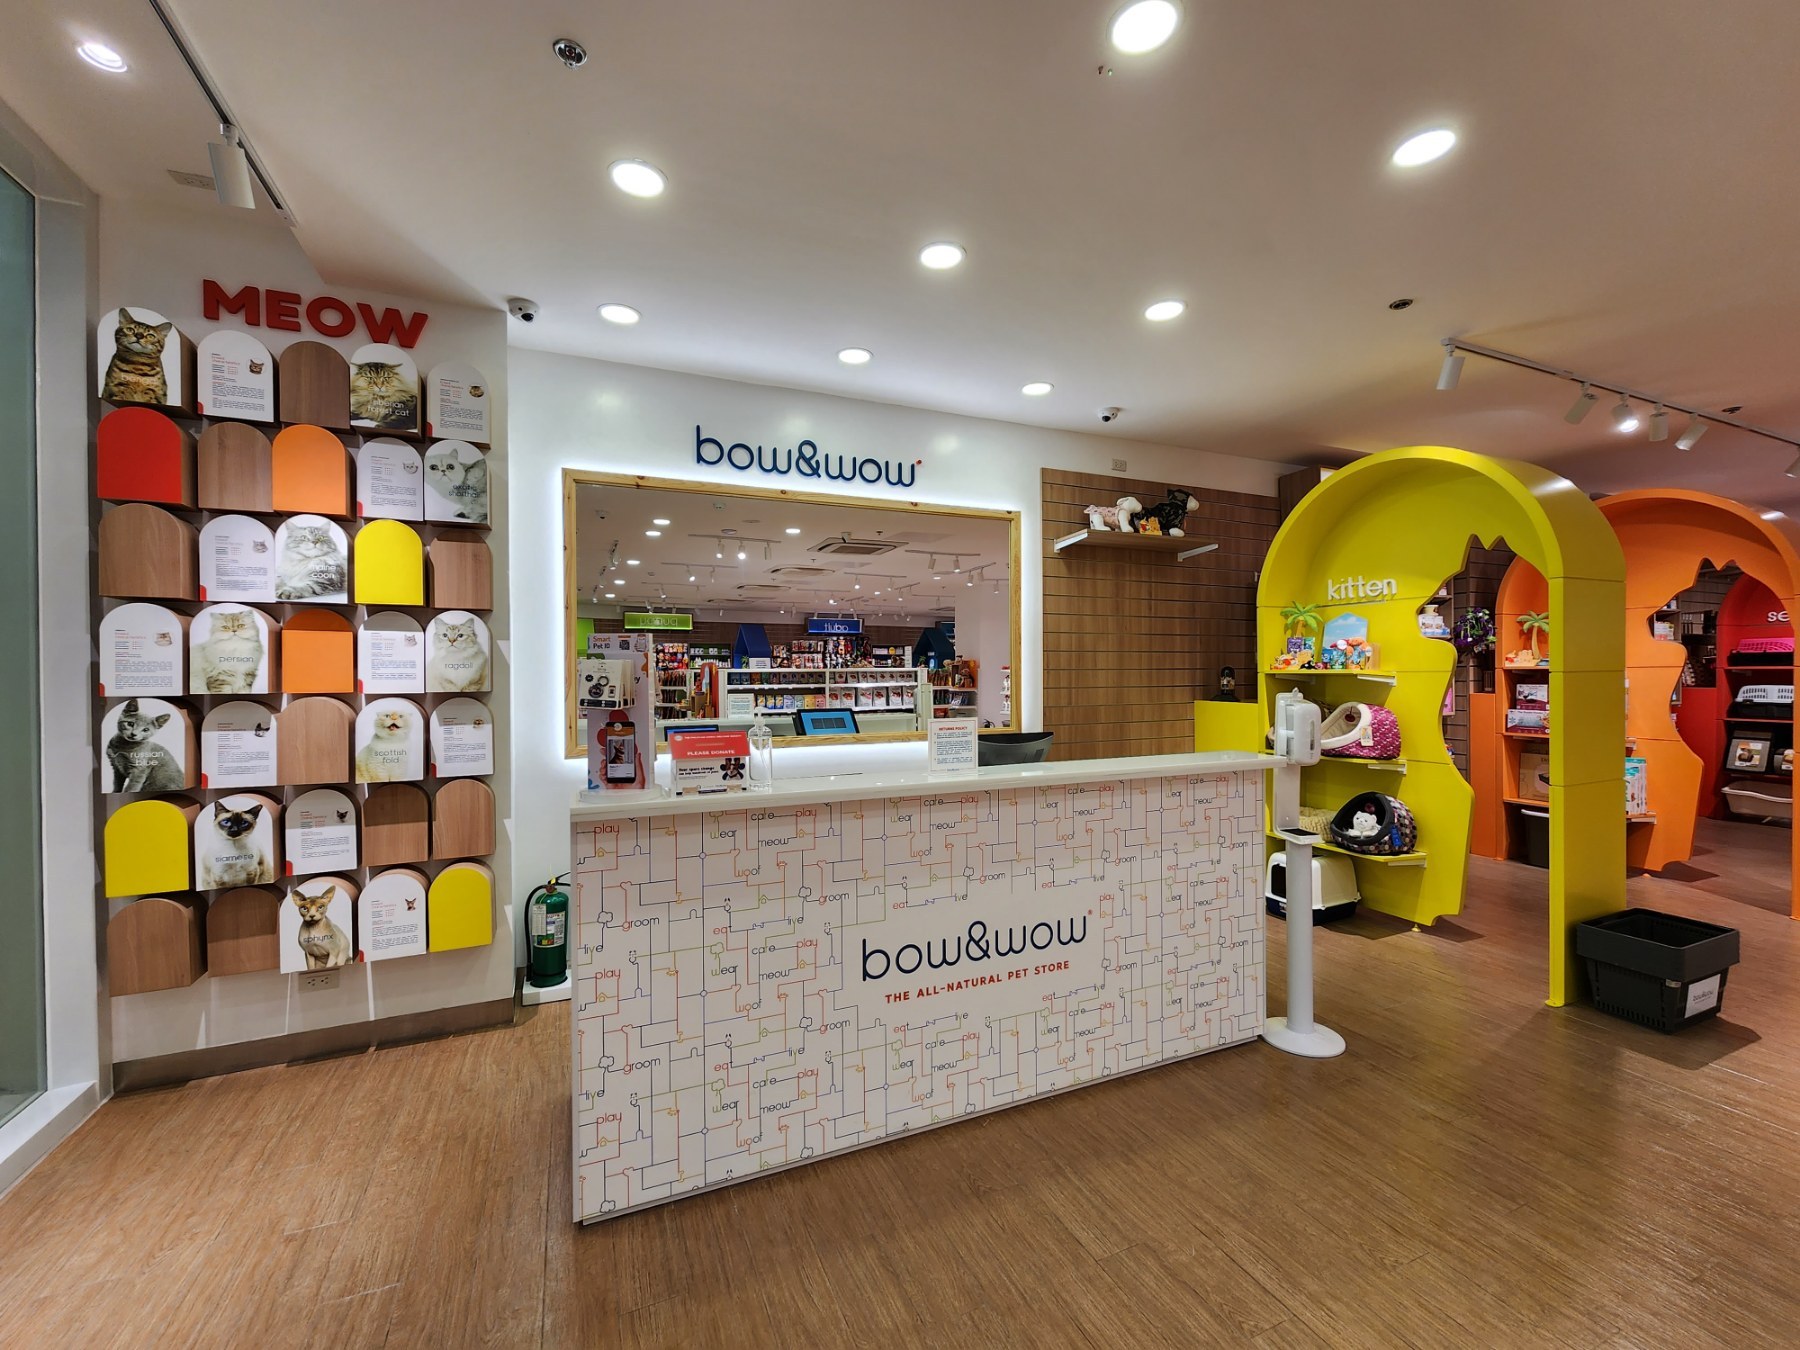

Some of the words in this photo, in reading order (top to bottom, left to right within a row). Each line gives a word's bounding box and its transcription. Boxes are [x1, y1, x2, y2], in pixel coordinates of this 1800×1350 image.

[203, 279, 428, 348] MEOW
[395, 409, 410, 417] cat
[696, 424, 915, 487] bow&wow
[1328, 576, 1398, 600] kitten
[374, 749, 407, 757] scottish
[1099, 784, 1114, 792] play
[961, 796, 979, 804] play
[1040, 801, 1059, 809] wear
[796, 808, 817, 818] play
[890, 814, 912, 823] wear
[594, 823, 620, 835] play
[930, 822, 956, 830] meow
[710, 830, 737, 840] wear
[759, 838, 789, 847] meow
[215, 853, 254, 863] siamese
[1115, 856, 1137, 866] groom
[979, 872, 1005, 884] groom
[819, 893, 850, 905] groom
[1100, 893, 1115, 901] play
[622, 917, 660, 931] groom
[303, 934, 334, 944] sphynx
[797, 938, 817, 949] play
[711, 965, 738, 976] wear
[1115, 962, 1138, 974] groom
[595, 969, 620, 981] play
[760, 969, 790, 980] meow
[885, 991, 910, 1004] THE
[917, 974, 1003, 998] ALL-NATURAL
[1008, 968, 1029, 980] PET
[1034, 960, 1070, 975] STORE
[1100, 1001, 1115, 1010] play
[820, 1020, 850, 1034] groom
[1041, 1026, 1060, 1036] wear
[1074, 1027, 1096, 1038] meow
[963, 1032, 980, 1041] play
[623, 1058, 661, 1074] groom
[893, 1059, 914, 1070] wear
[931, 1060, 957, 1072] meow
[797, 1068, 819, 1080] play
[712, 1100, 739, 1113] wear
[760, 1101, 790, 1113] meow
[596, 1112, 622, 1124] play
